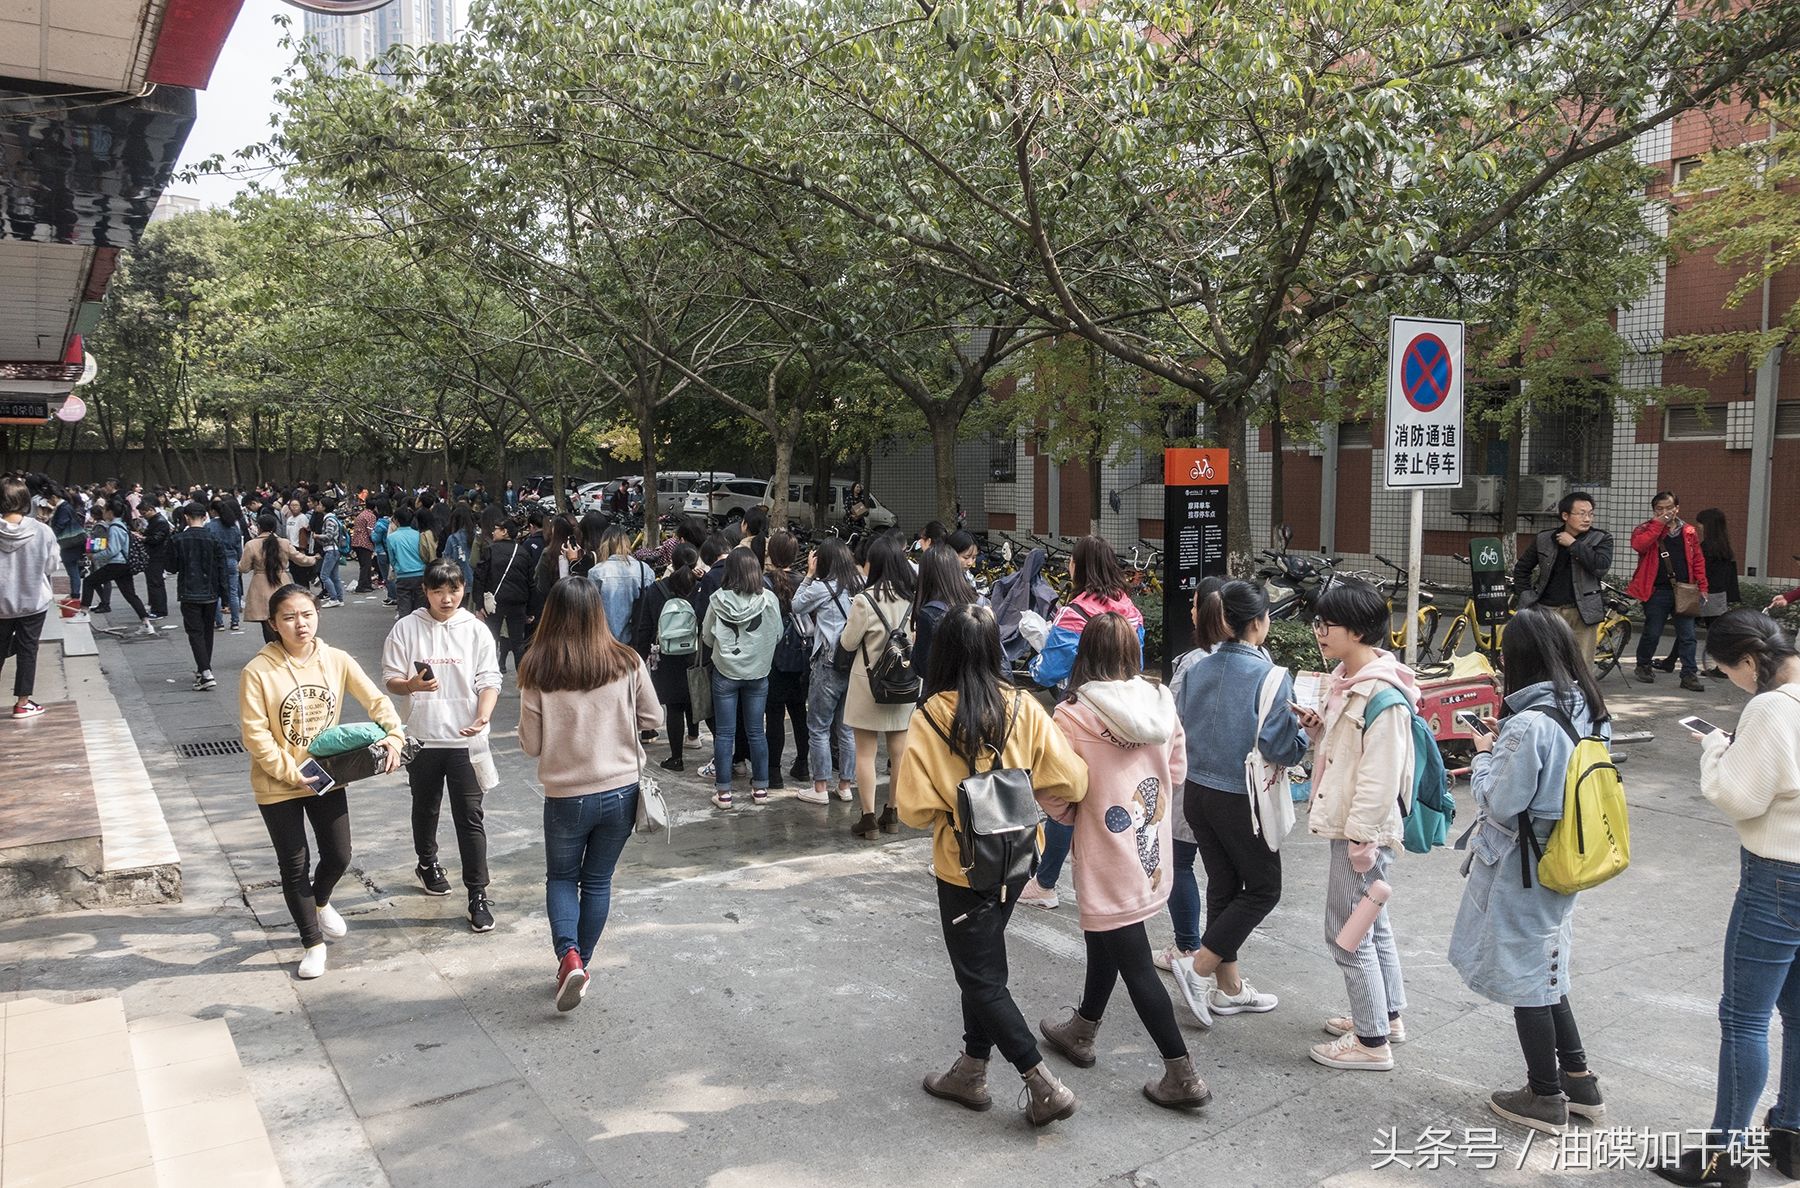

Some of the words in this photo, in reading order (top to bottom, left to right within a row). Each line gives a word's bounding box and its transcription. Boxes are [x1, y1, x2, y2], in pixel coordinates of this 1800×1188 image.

[1395, 424, 1456, 447] 消防通道
[1394, 452, 1456, 475] 禁止停车
